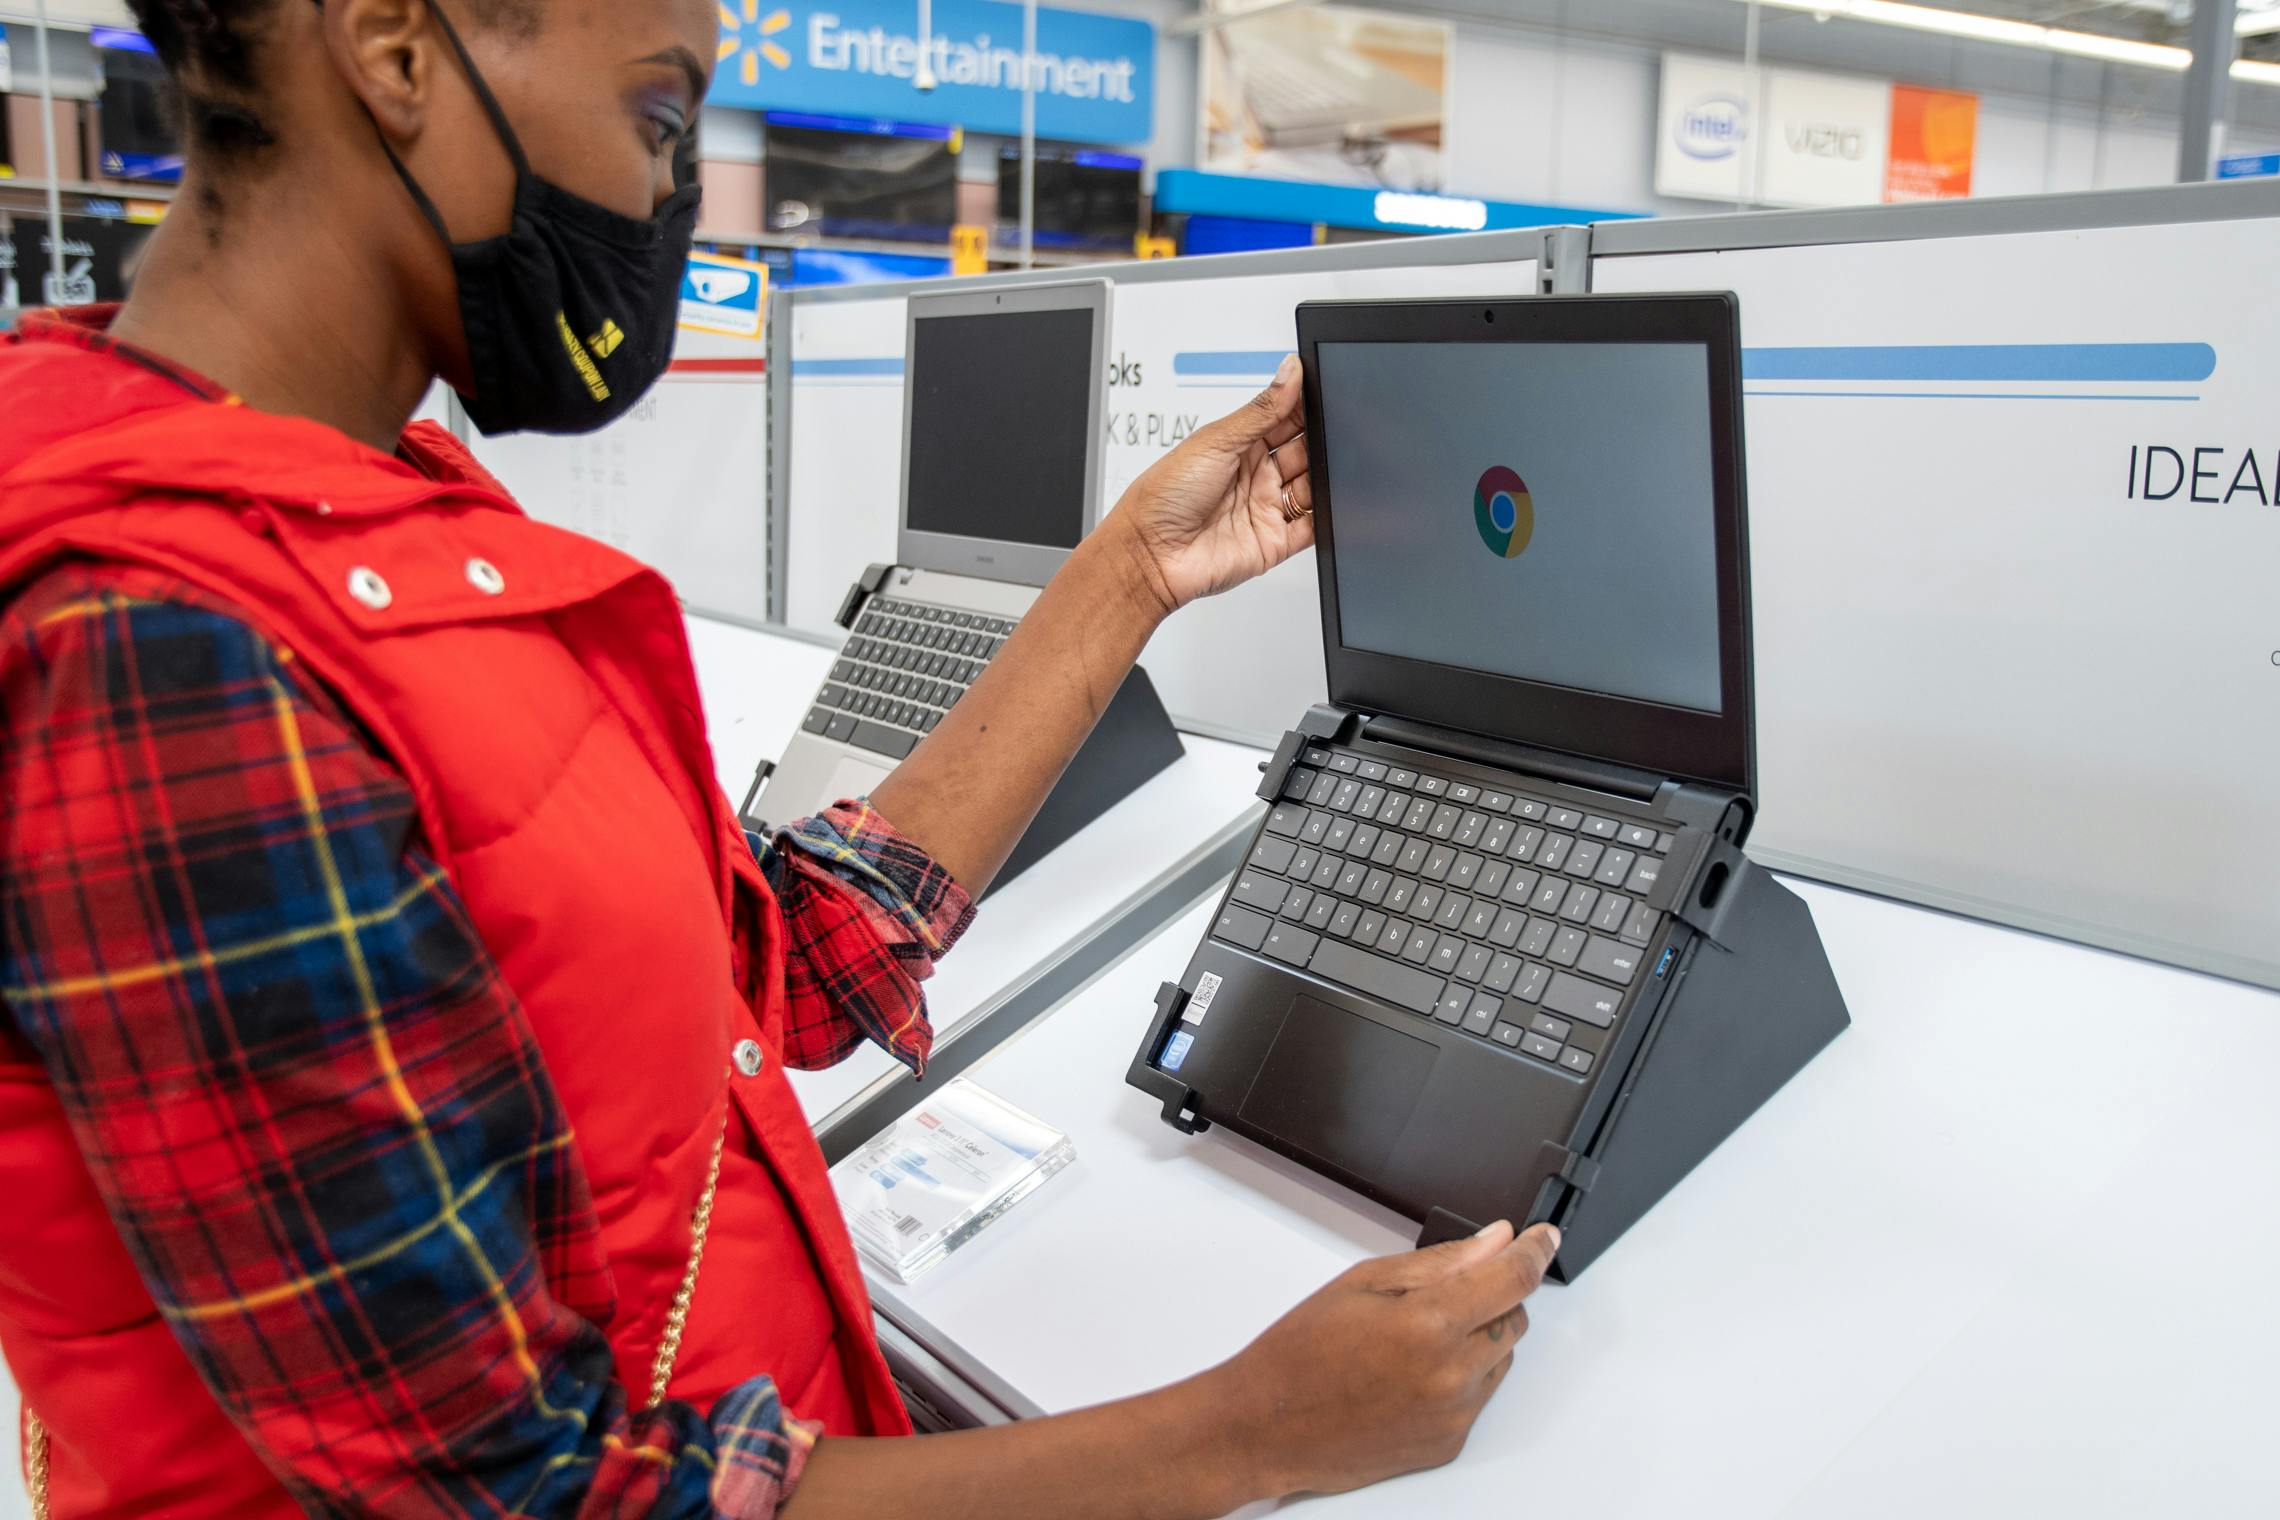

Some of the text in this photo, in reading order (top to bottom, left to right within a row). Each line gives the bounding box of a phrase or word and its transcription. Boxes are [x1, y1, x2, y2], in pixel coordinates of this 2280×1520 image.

[807, 12, 1135, 103] Entetainment
[1127, 413, 1139, 446] &
[2128, 445, 2280, 506] IDEA
[1337, 796, 1346, 806] 2
[1361, 803, 1369, 813] 3
[1386, 809, 1393, 819] 4
[1410, 815, 1419, 826] 5
[1436, 823, 1444, 833] 6
[1461, 829, 1471, 840] 7
[1489, 837, 1498, 848] 8
[1517, 844, 1526, 855] 9
[1546, 852, 1555, 863] 0
[1299, 859, 1307, 868] a
[1322, 866, 1330, 876] s
[1346, 872, 1356, 884] d
[1371, 879, 1380, 891] f
[1394, 889, 1404, 902] g
[1421, 895, 1429, 908] h
[1447, 903, 1457, 918] j
[1474, 911, 1484, 924] k
[1312, 823, 1320, 834] q
[1335, 829, 1344, 839] w
[1359, 836, 1366, 845] e
[1383, 843, 1391, 852] r
[1409, 848, 1416, 860] t
[1432, 858, 1443, 870] y
[1460, 865, 1469, 875] u
[1488, 871, 1496, 883] i
[1515, 881, 1525, 891] o
[1543, 889, 1553, 902] p
[1639, 869, 1657, 881] back
[1293, 898, 1301, 907] z
[1316, 906, 1324, 915] x
[1340, 914, 1348, 924] c
[1365, 922, 1373, 932] v
[1389, 927, 1398, 941] b
[1415, 939, 1424, 949] n
[1440, 948, 1452, 959] m
